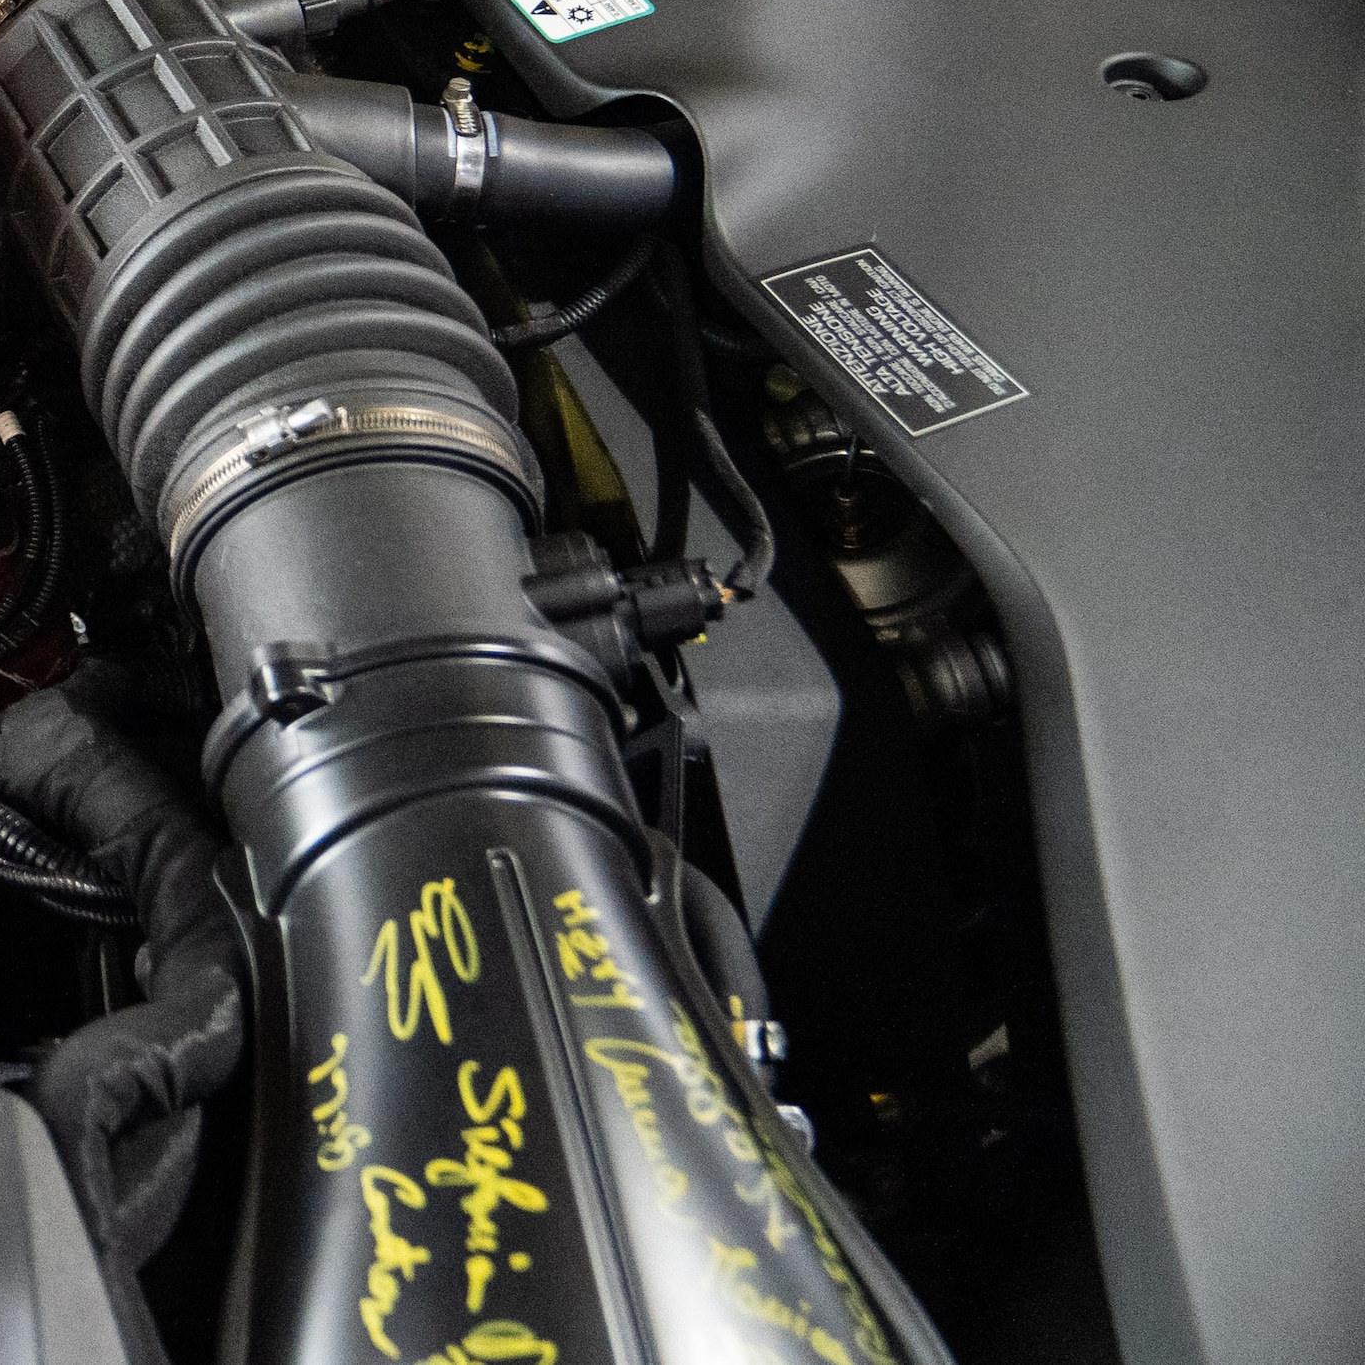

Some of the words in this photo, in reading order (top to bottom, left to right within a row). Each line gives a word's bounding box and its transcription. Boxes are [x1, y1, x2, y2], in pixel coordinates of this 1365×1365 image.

[806, 300, 881, 366] TENSIONE
[861, 304, 937, 368] WARNING
[863, 286, 930, 342] VOLTAGE
[799, 312, 890, 396] ATTENZIONE
[870, 364, 914, 399] ALTA
[920, 340, 967, 376] HIGH
